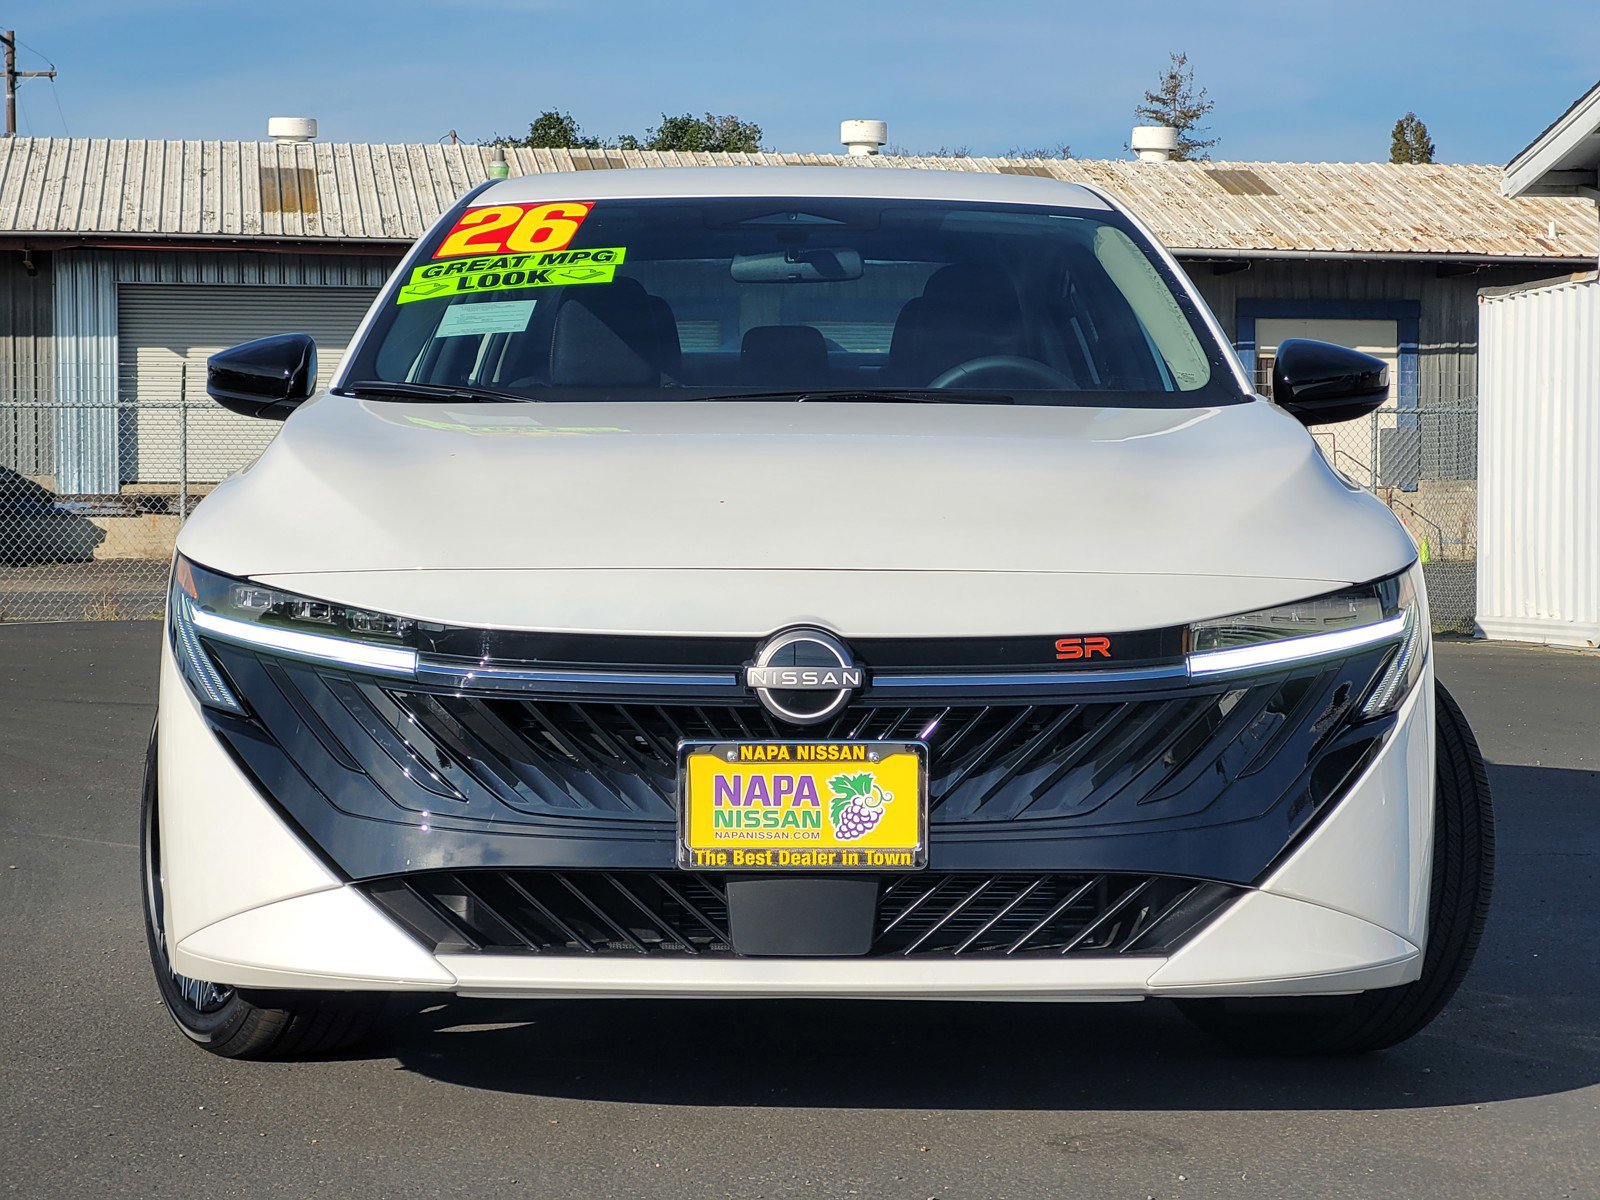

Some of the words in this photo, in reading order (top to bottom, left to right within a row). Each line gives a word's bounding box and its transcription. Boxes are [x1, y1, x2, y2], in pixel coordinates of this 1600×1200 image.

[436, 202, 588, 257] 26
[421, 255, 531, 279] GREAT
[537, 250, 616, 266] MPG
[456, 269, 552, 291] LOOK
[1055, 636, 1111, 659] SR
[750, 671, 860, 685] NISSAN
[740, 745, 790, 760] NAPA
[797, 745, 865, 760] NISSAN
[714, 775, 820, 806] NAPA
[714, 810, 821, 828] NISSAN
[714, 831, 820, 840] NAPANISSAN.COM
[695, 850, 729, 866] The
[733, 850, 772, 866] Best
[778, 850, 836, 866] Dealer
[842, 850, 861, 866] in
[865, 850, 911, 866] Town
